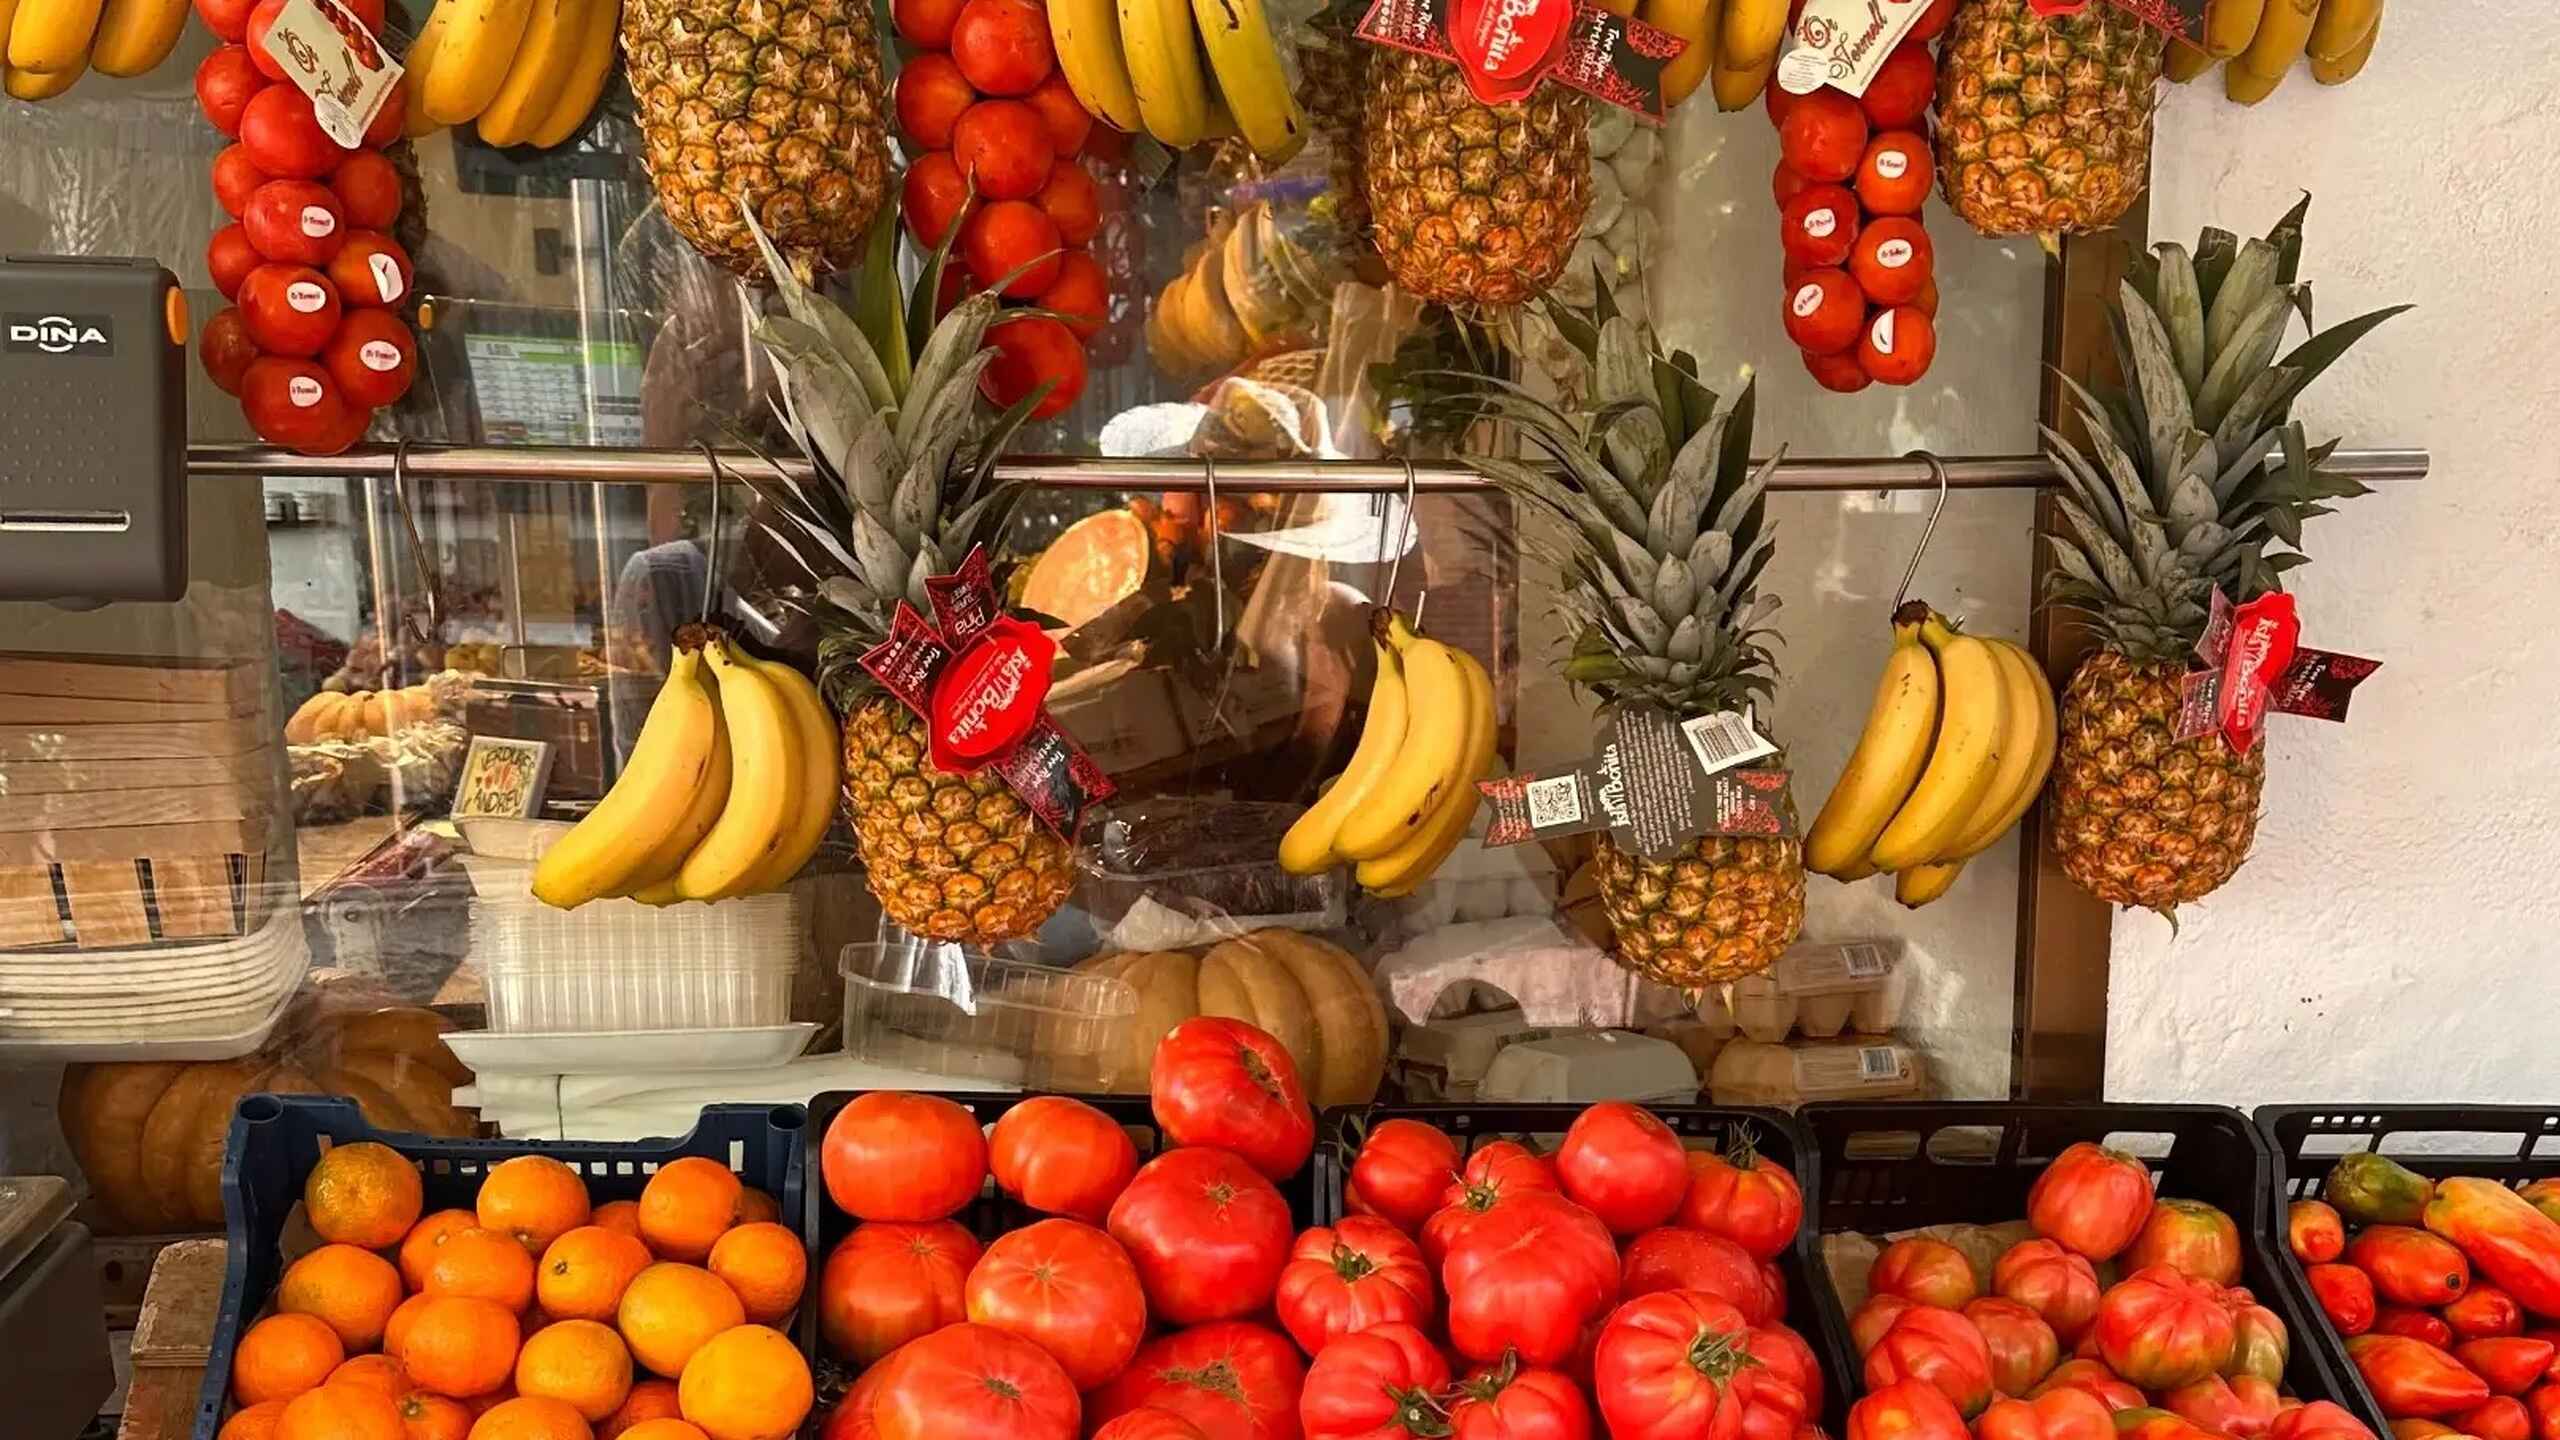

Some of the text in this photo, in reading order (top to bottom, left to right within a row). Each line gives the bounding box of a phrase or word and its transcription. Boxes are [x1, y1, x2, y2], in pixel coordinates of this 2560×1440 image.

[10, 325, 107, 343] DINA
[946, 685, 1002, 743] Bonita
[1597, 743, 1623, 792] Bonita
